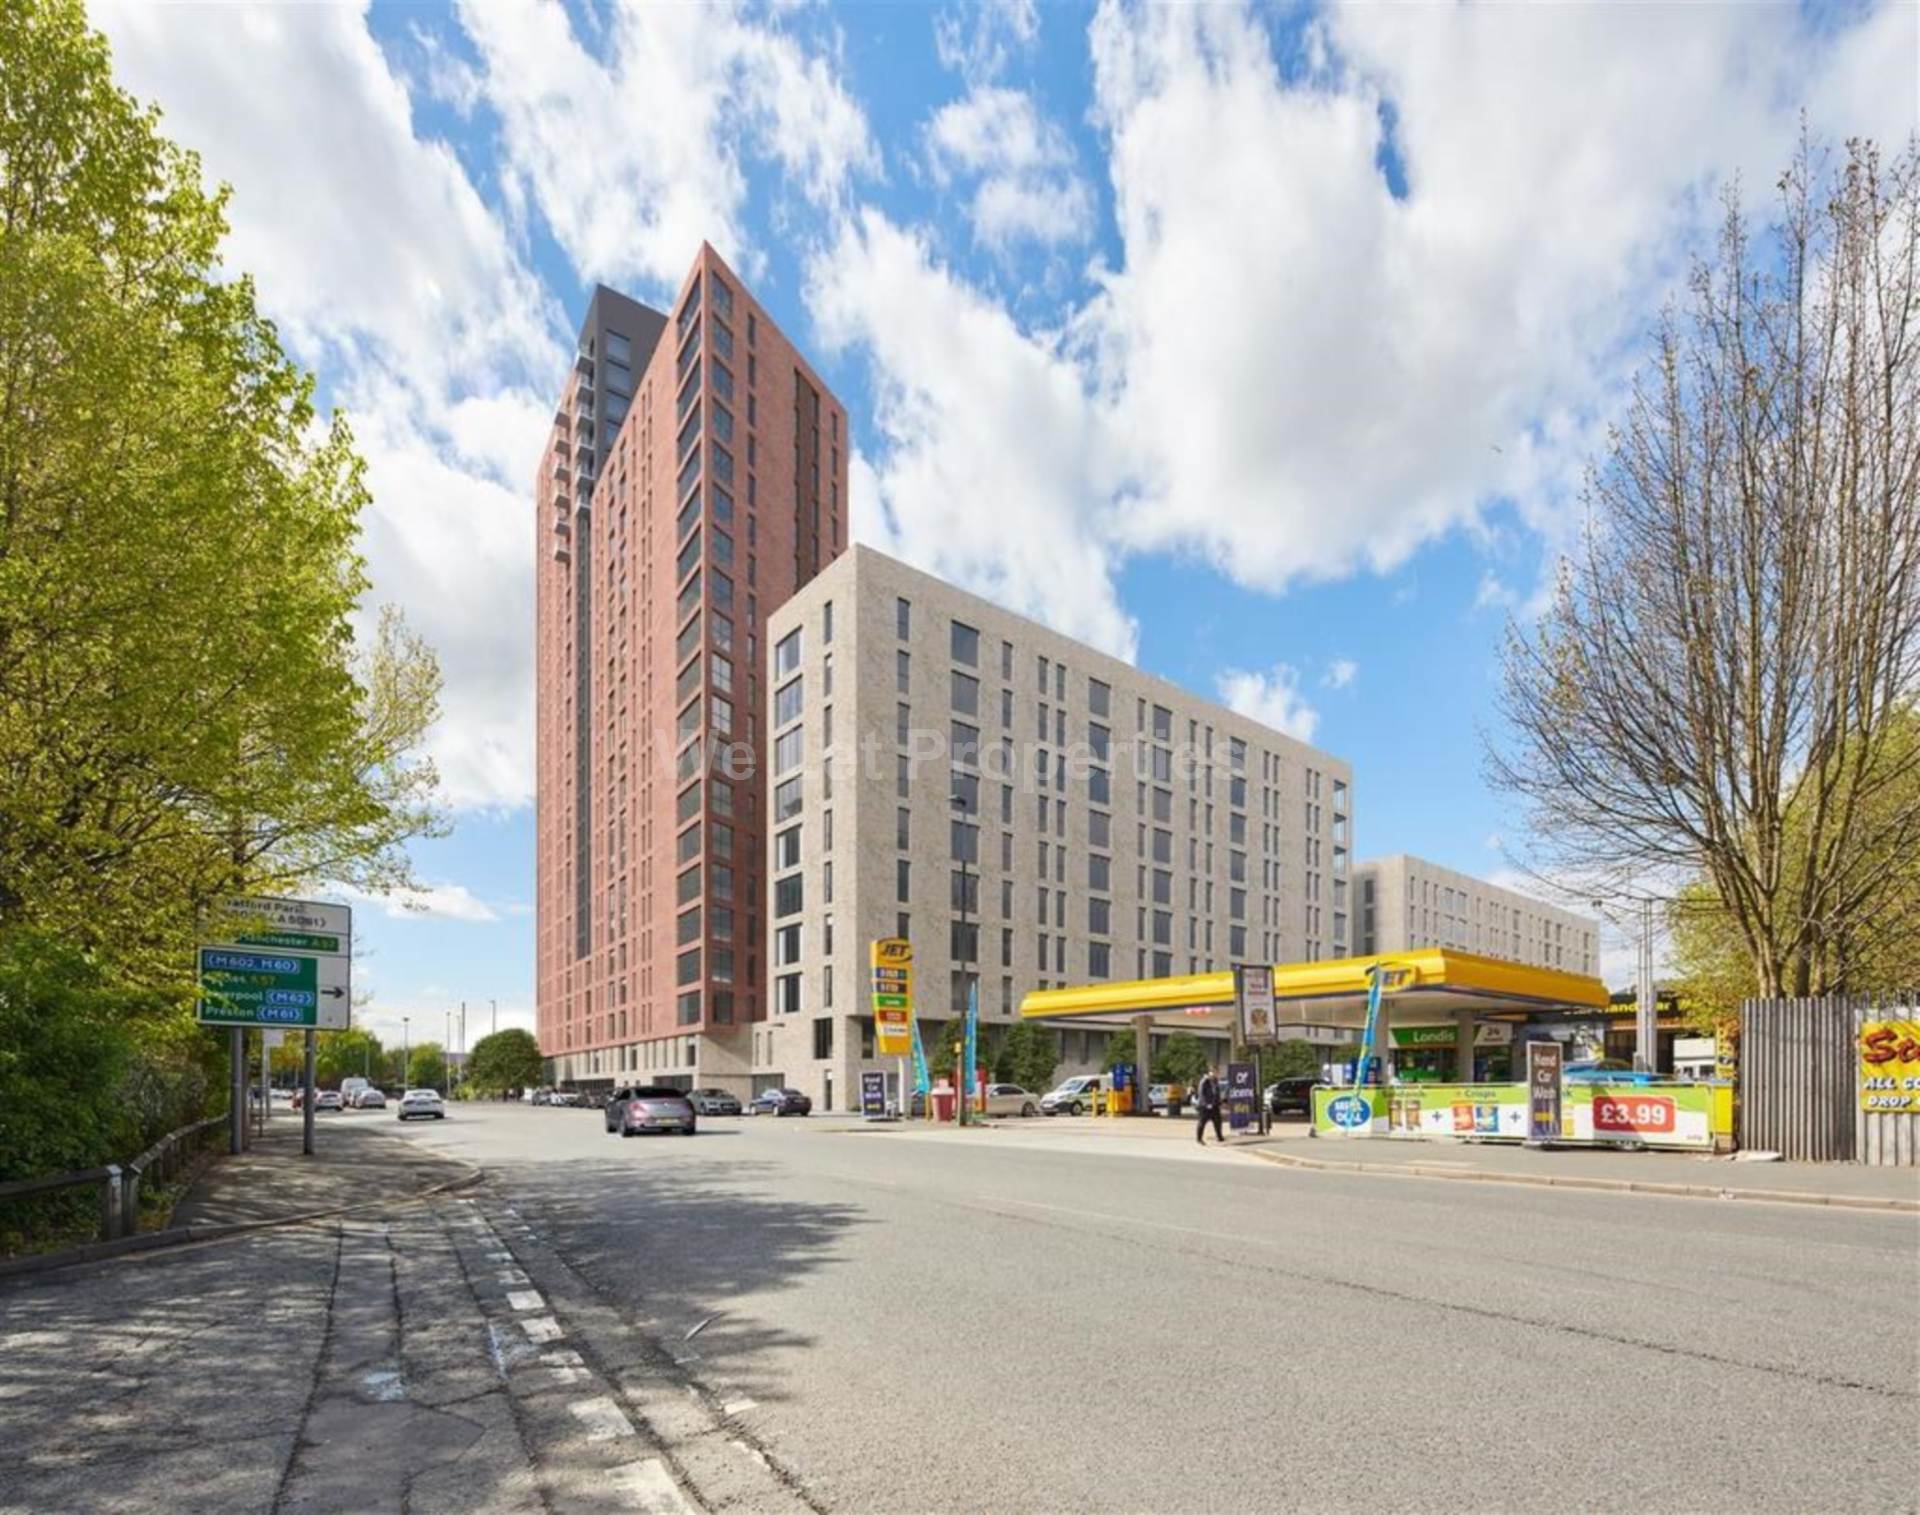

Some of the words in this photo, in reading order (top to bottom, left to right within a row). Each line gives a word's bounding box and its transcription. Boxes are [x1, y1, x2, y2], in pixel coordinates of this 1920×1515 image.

[884, 943, 909, 957] JET
[1413, 1031, 1455, 1044] Londis
[1537, 1070, 1552, 1083] Car
[1864, 1076, 1896, 1090] ALL
[1867, 1095, 1912, 1108] DROP
[1601, 1103, 1667, 1126] £3.99
